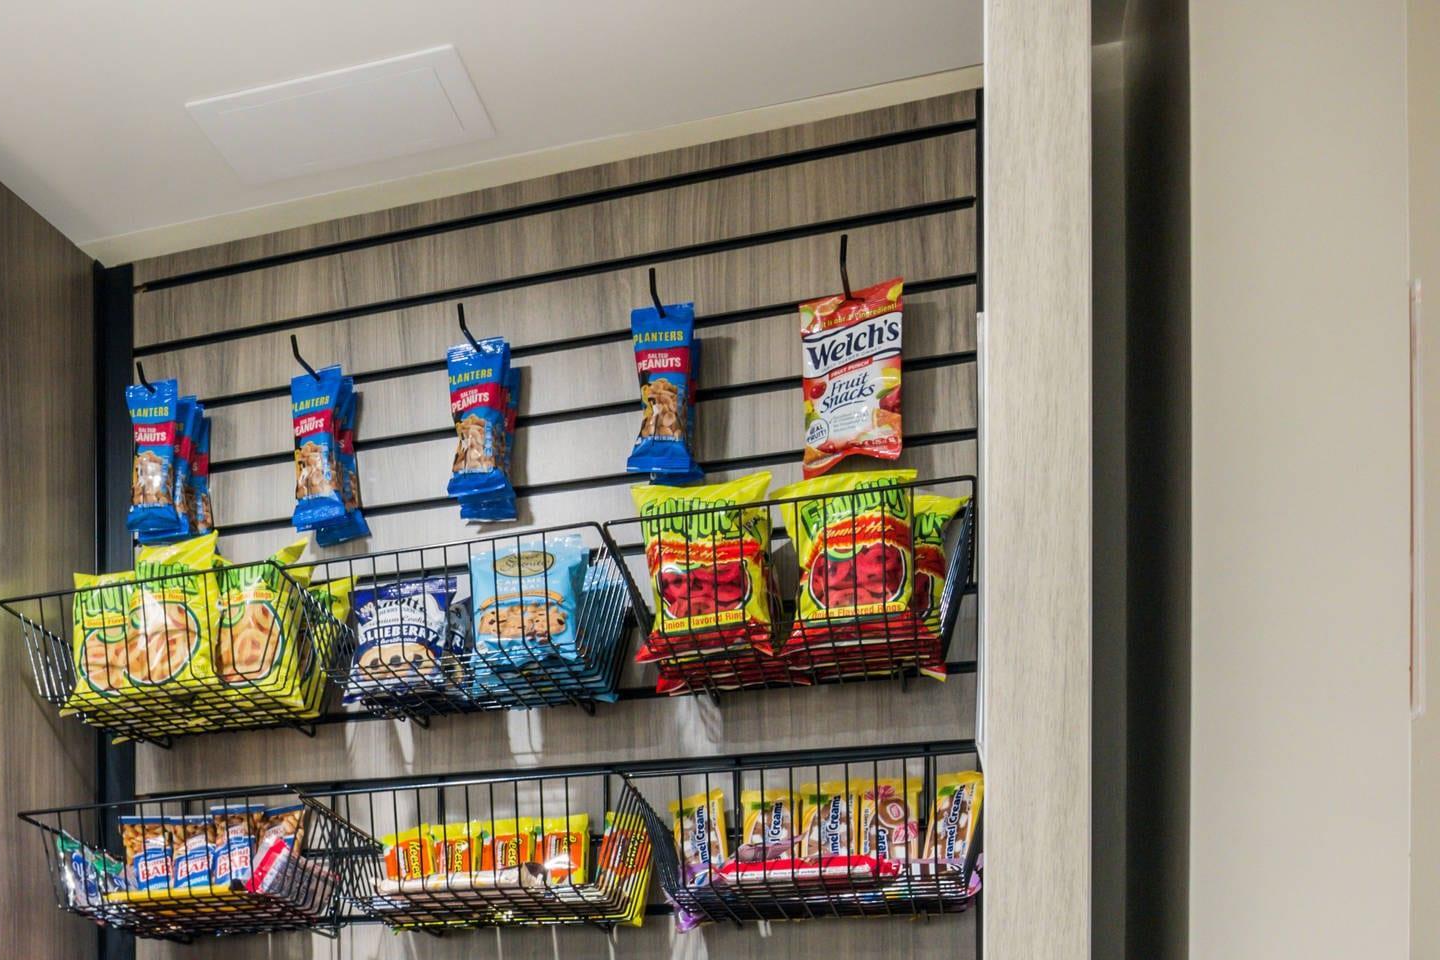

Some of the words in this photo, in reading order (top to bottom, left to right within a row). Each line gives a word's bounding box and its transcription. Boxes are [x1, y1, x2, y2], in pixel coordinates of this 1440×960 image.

[633, 331, 683, 345] PLANTERS
[807, 320, 900, 370] Welch's
[449, 368, 493, 385] PLANTERS
[638, 357, 681, 371] PEANUTS
[830, 371, 870, 396] Fruit
[452, 391, 490, 411] PEANUTS
[820, 383, 876, 414] Snacks
[134, 432, 167, 442] EANUTS
[359, 625, 438, 645] BLUEBERRY
[828, 794, 841, 832] Creams
[947, 784, 965, 826] Creams
[695, 804, 705, 839] Creams
[770, 802, 783, 836] Creams
